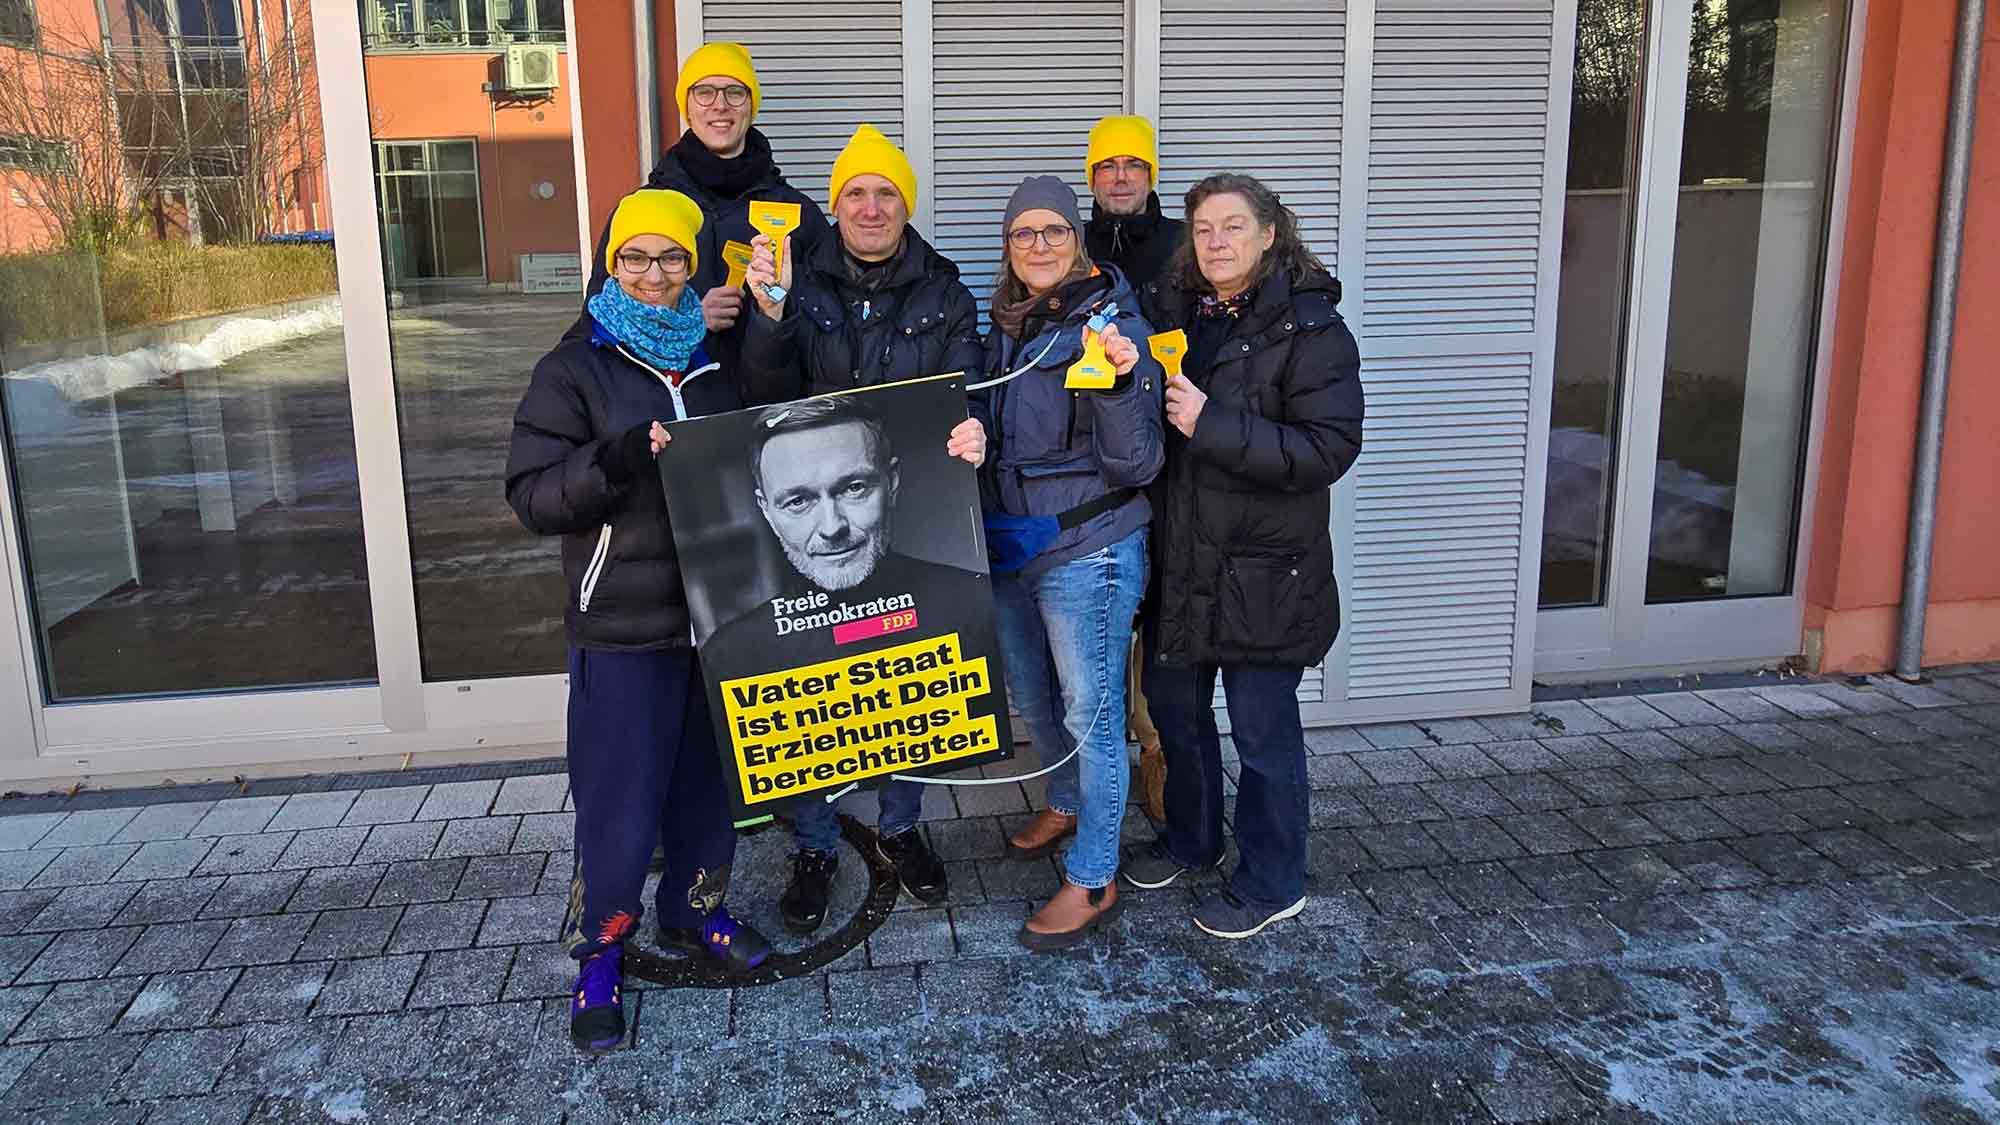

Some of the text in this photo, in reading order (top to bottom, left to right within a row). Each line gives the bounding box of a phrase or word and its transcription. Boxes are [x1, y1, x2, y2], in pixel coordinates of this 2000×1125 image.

[771, 591, 828, 617] Freie
[775, 592, 915, 636] Demokraten
[882, 614, 913, 631] FDP
[732, 643, 953, 709] Vater Staat
[737, 670, 981, 738] ist nicht Dein
[743, 709, 959, 767] Erziehungs-
[750, 727, 990, 795] berechtigter.
